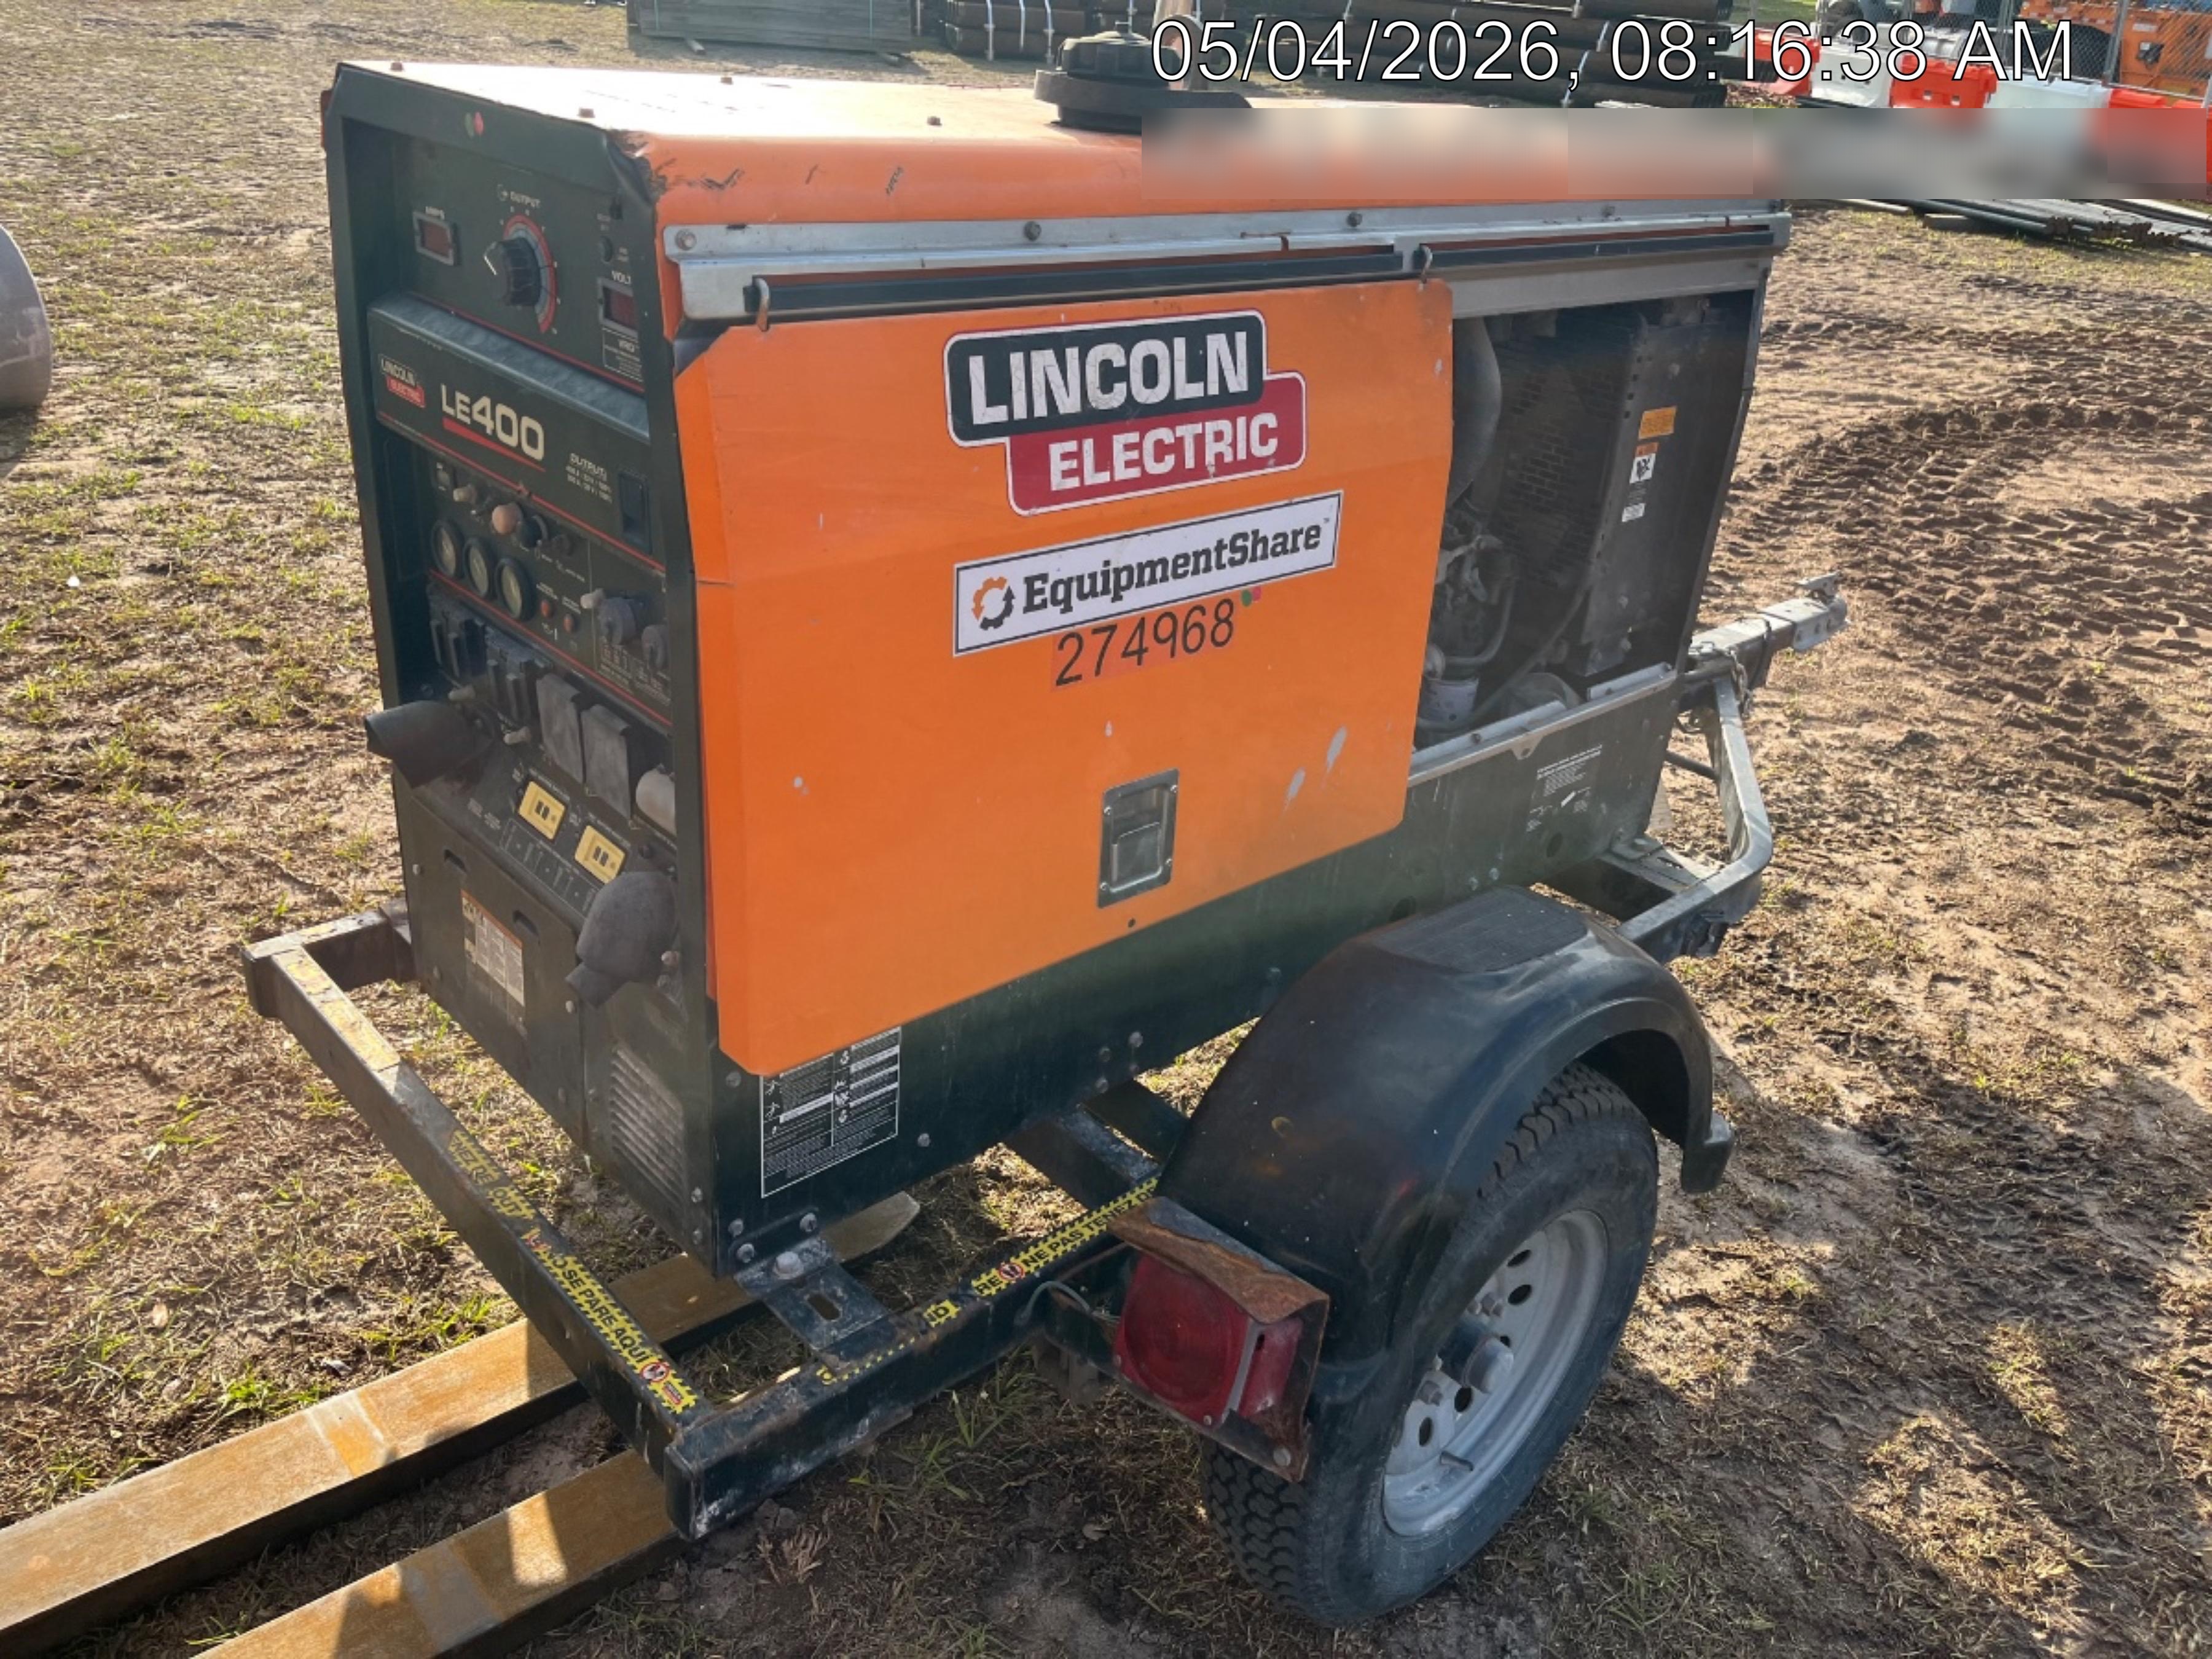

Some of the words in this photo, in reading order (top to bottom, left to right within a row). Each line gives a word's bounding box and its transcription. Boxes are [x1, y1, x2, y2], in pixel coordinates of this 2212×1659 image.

[969, 331, 1249, 425] LINCOLN
[441, 383, 544, 461] LE400
[1049, 412, 1279, 492] ELECTRIC
[1022, 523, 1321, 614] EquipmentShare
[1055, 598, 1234, 686] 274968
[1021, 1249, 1048, 1264] NE
[1048, 1230, 1084, 1251] PAS
[562, 1269, 586, 1288] SE
[578, 1288, 618, 1326] PARE
